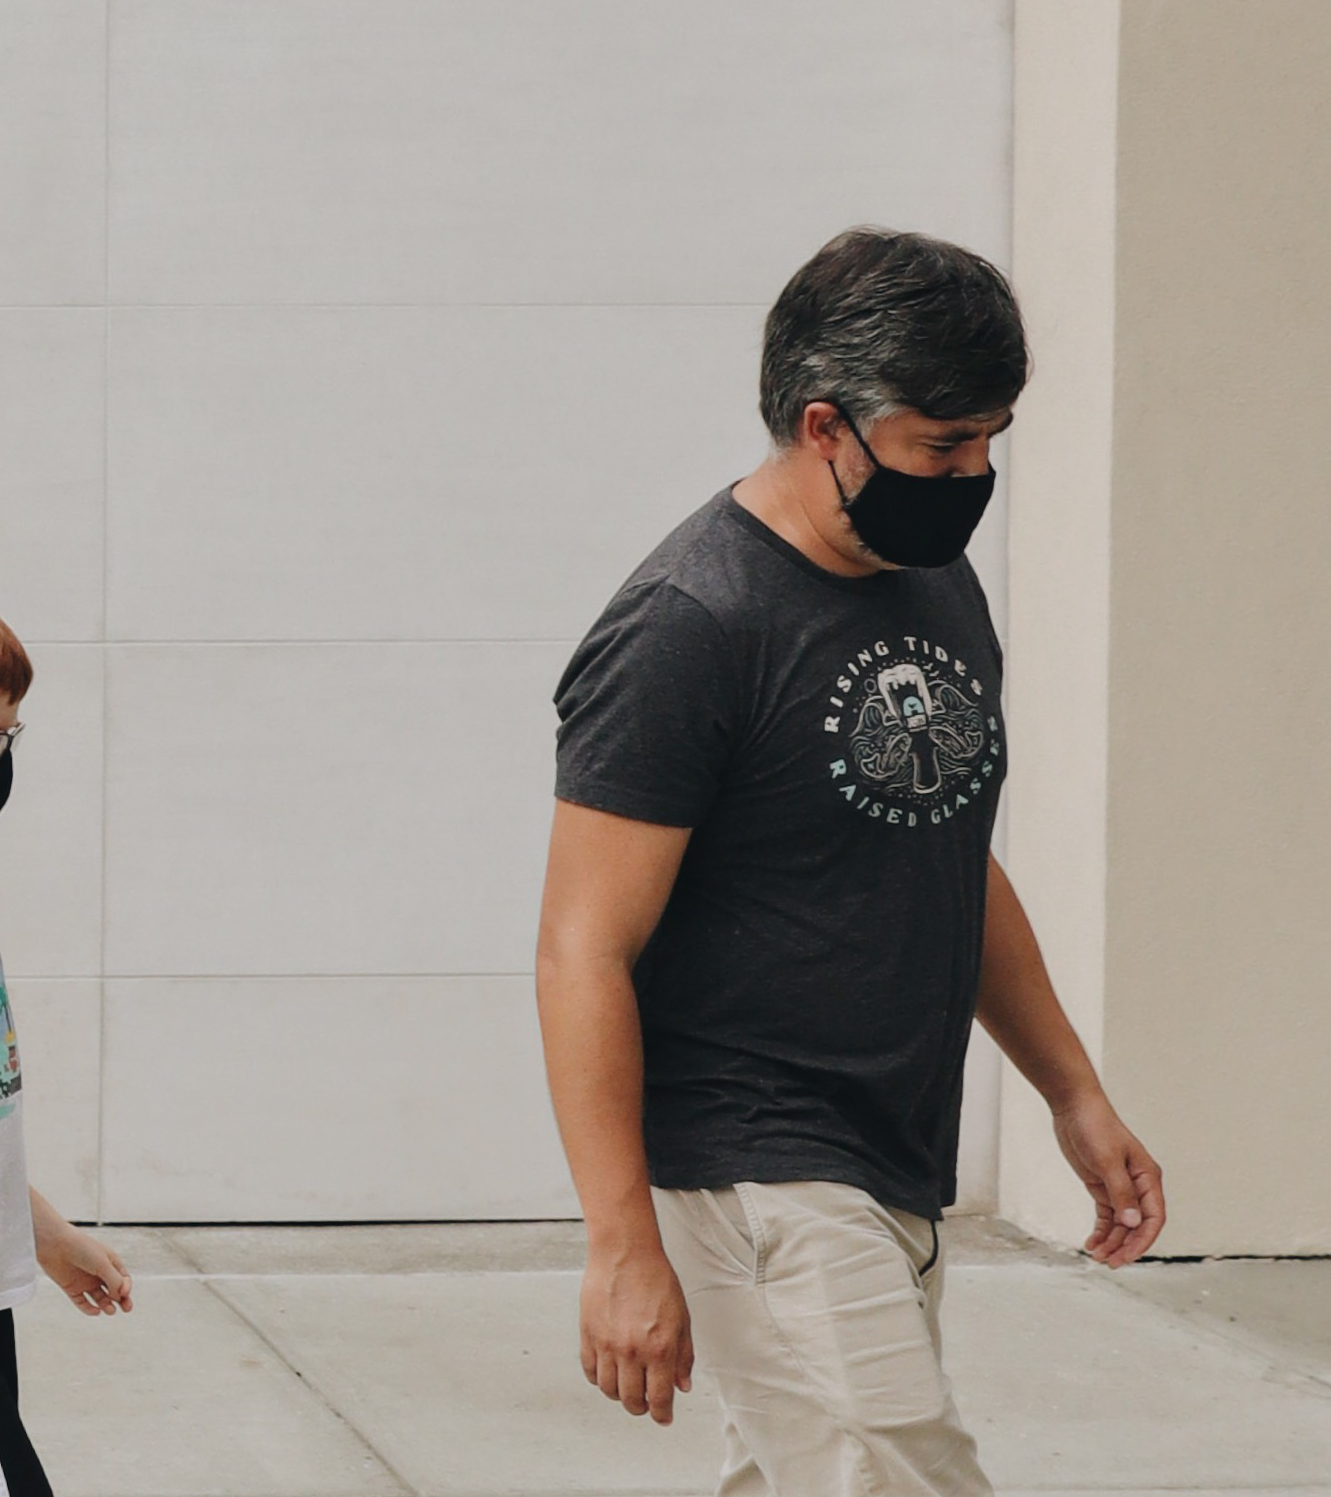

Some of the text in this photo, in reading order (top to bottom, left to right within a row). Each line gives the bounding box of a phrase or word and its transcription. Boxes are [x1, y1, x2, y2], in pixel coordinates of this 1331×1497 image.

[824, 636, 983, 733] RISING TIDES
[829, 715, 1000, 827] RAISED GLASSES
